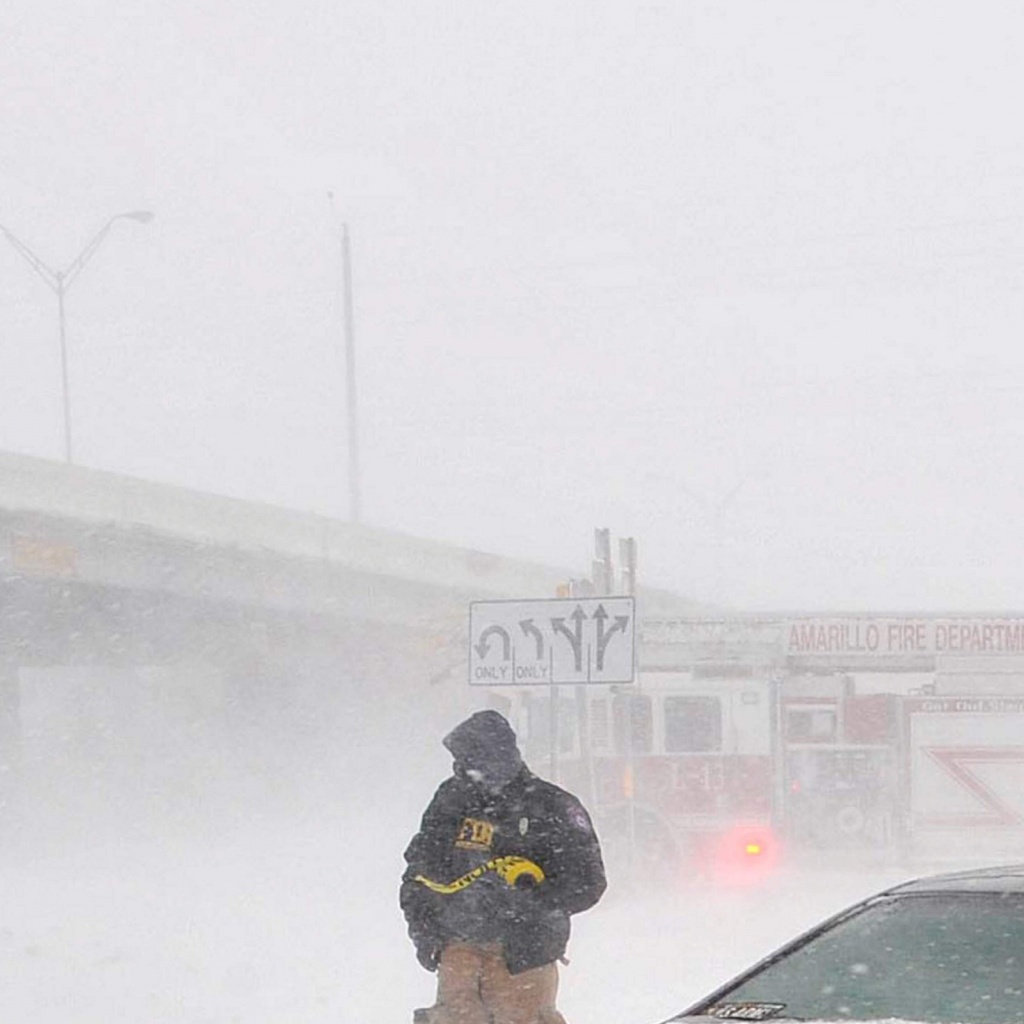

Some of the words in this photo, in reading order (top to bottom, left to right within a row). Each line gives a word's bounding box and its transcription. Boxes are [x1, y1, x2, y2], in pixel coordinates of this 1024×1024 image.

[787, 623, 880, 652] AMARILLO
[887, 623, 927, 652] FIRE
[474, 666, 509, 680] ONLY
[515, 665, 548, 679] ONLY
